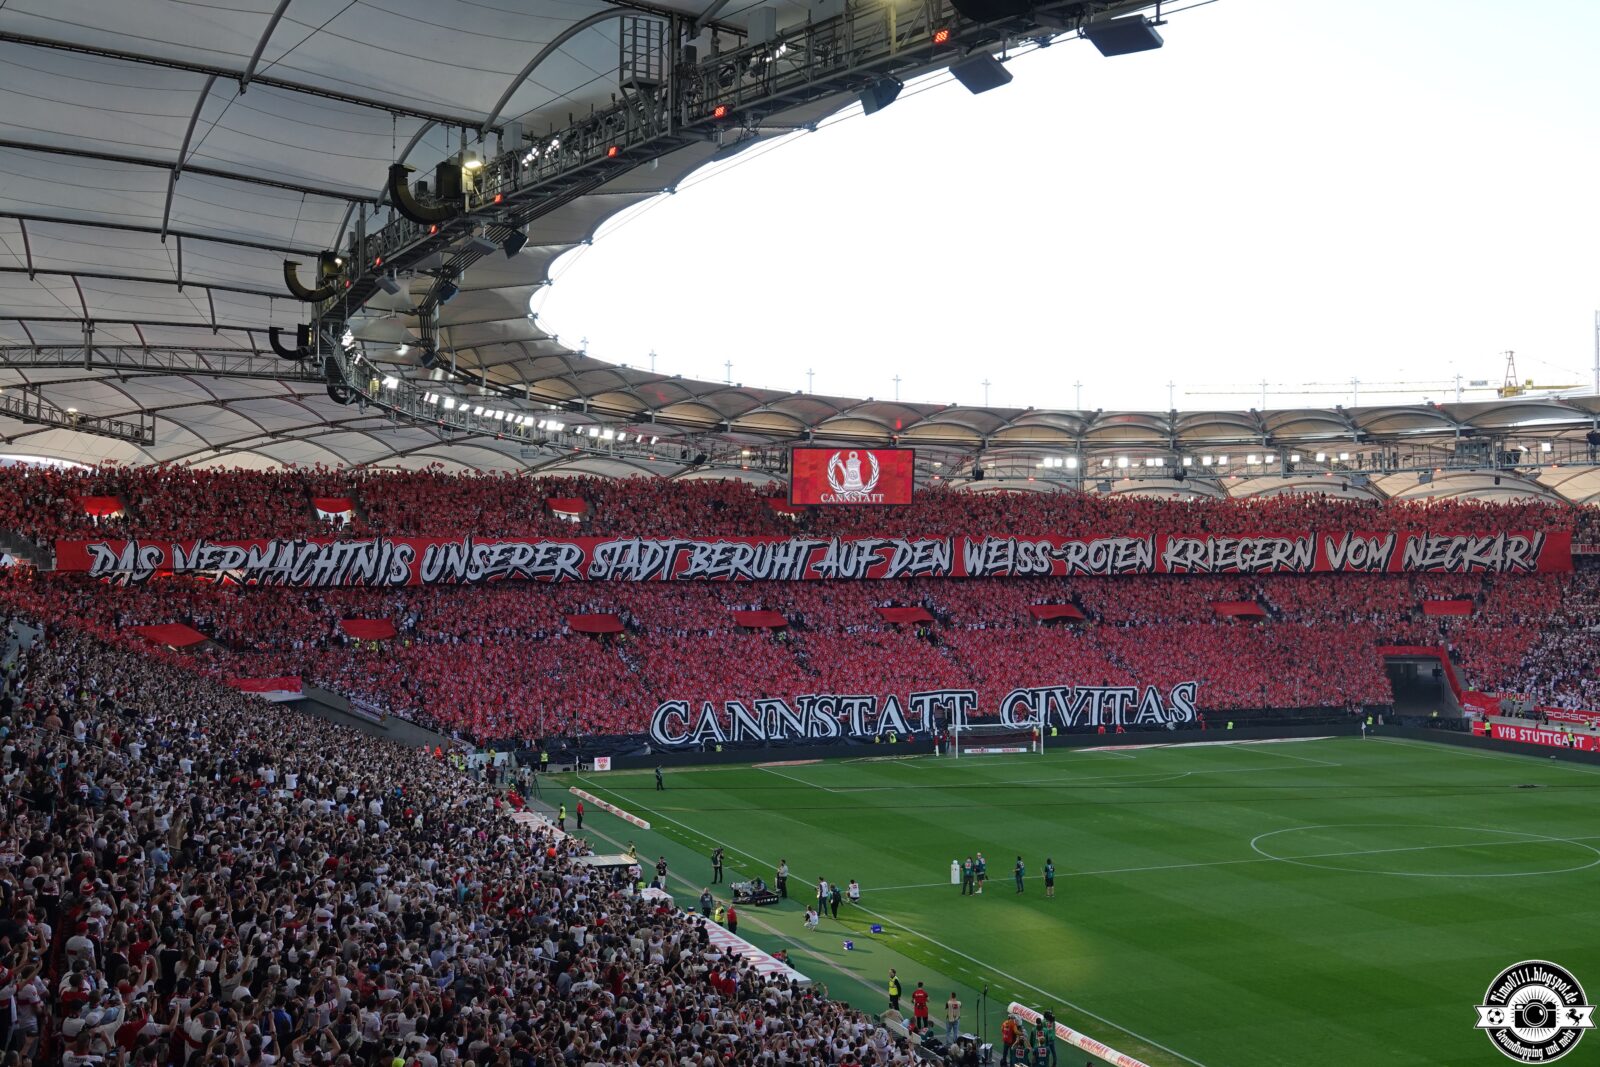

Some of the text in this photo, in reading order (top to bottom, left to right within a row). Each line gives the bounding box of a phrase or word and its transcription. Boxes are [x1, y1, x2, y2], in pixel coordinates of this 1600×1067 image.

[820, 493, 885, 503] CANNSTATT
[84, 540, 164, 586] DAS
[420, 533, 584, 585] UNSERER
[588, 536, 694, 581] STADT
[677, 536, 824, 581] BERUHT
[812, 535, 900, 580] AUF
[880, 535, 955, 579] DEN
[963, 534, 1157, 578] WEISS-ROTEN
[1161, 531, 1318, 573] KRIEGERN
[1324, 530, 1398, 573] VOM
[1403, 528, 1546, 573] NECKAR!
[651, 681, 1199, 747] CANNSTATT CIVITAS
[1498, 726, 1585, 748] VfB STUTTGART
